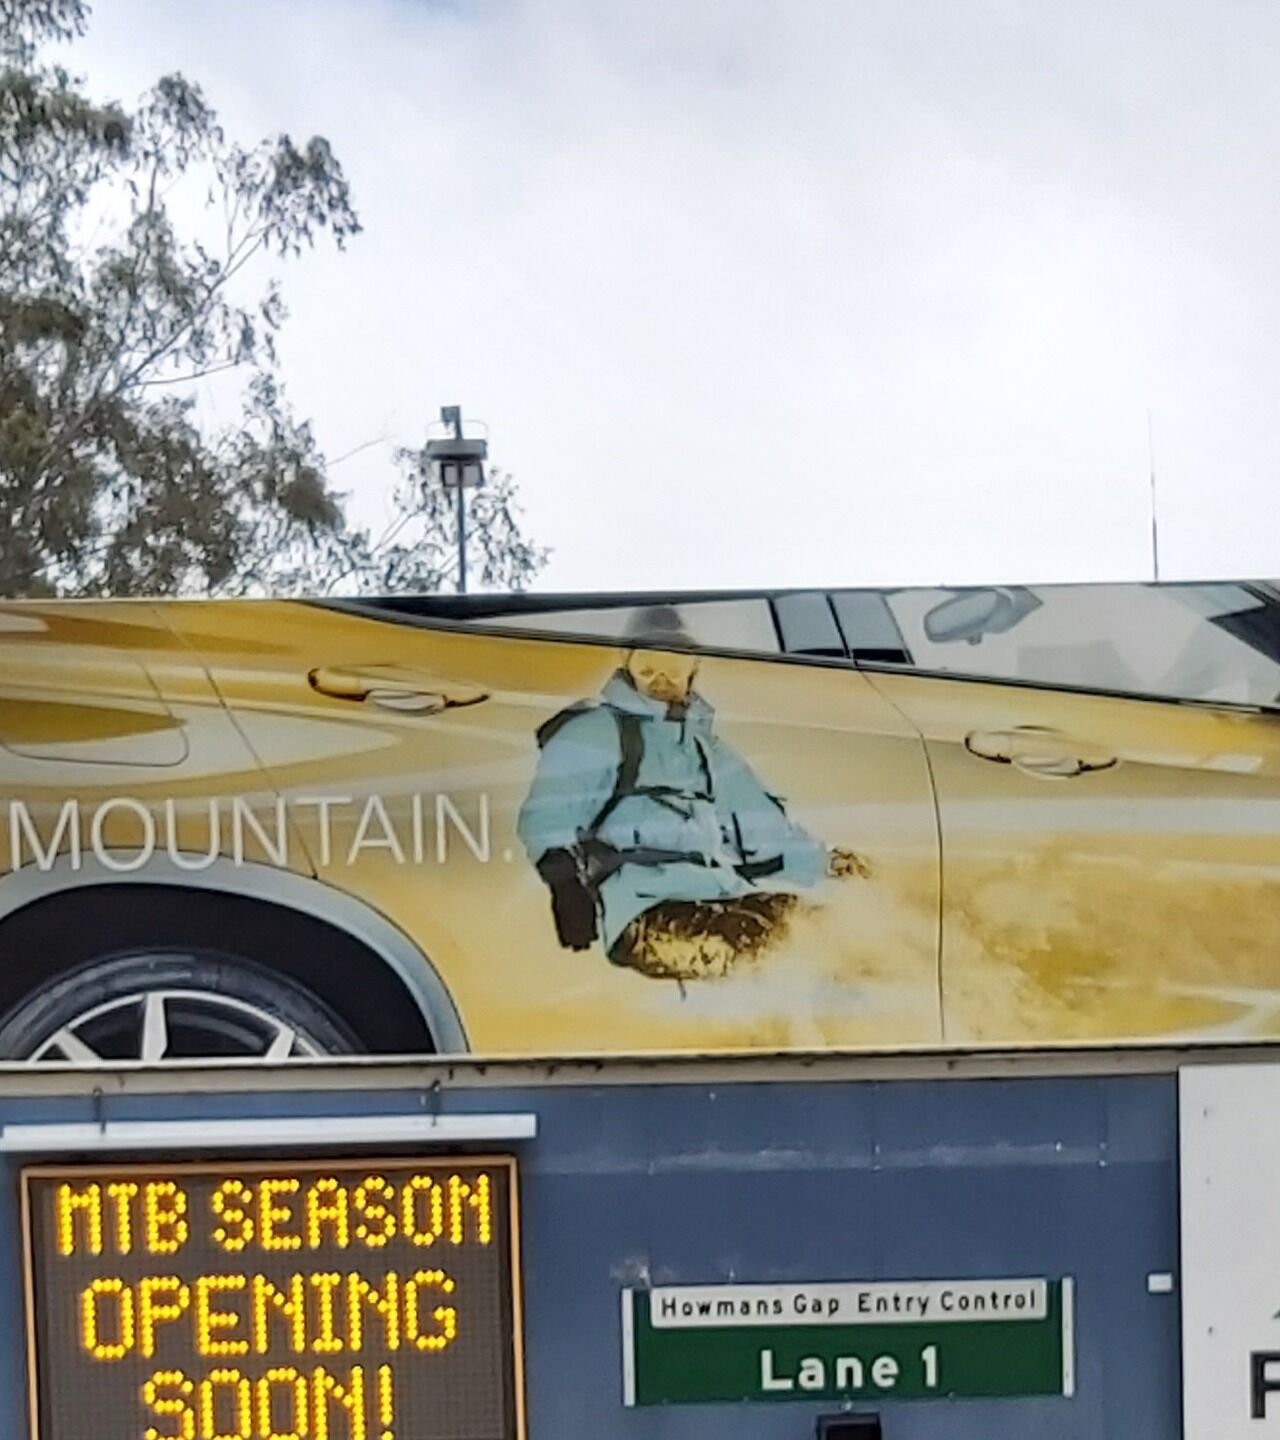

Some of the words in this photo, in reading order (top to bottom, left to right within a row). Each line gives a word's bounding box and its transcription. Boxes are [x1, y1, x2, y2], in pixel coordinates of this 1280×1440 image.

[7, 792, 516, 874] MOUNTAIN.
[55, 1179, 189, 1257] MTB
[211, 1171, 495, 1253] SEASON
[79, 1266, 459, 1361] OPENING
[661, 1295, 784, 1318] Howmans
[793, 1293, 840, 1317] Gap
[857, 1290, 932, 1316] Entry
[939, 1288, 1037, 1312] Control
[760, 1347, 900, 1392] Lane
[921, 1345, 939, 1388] 1
